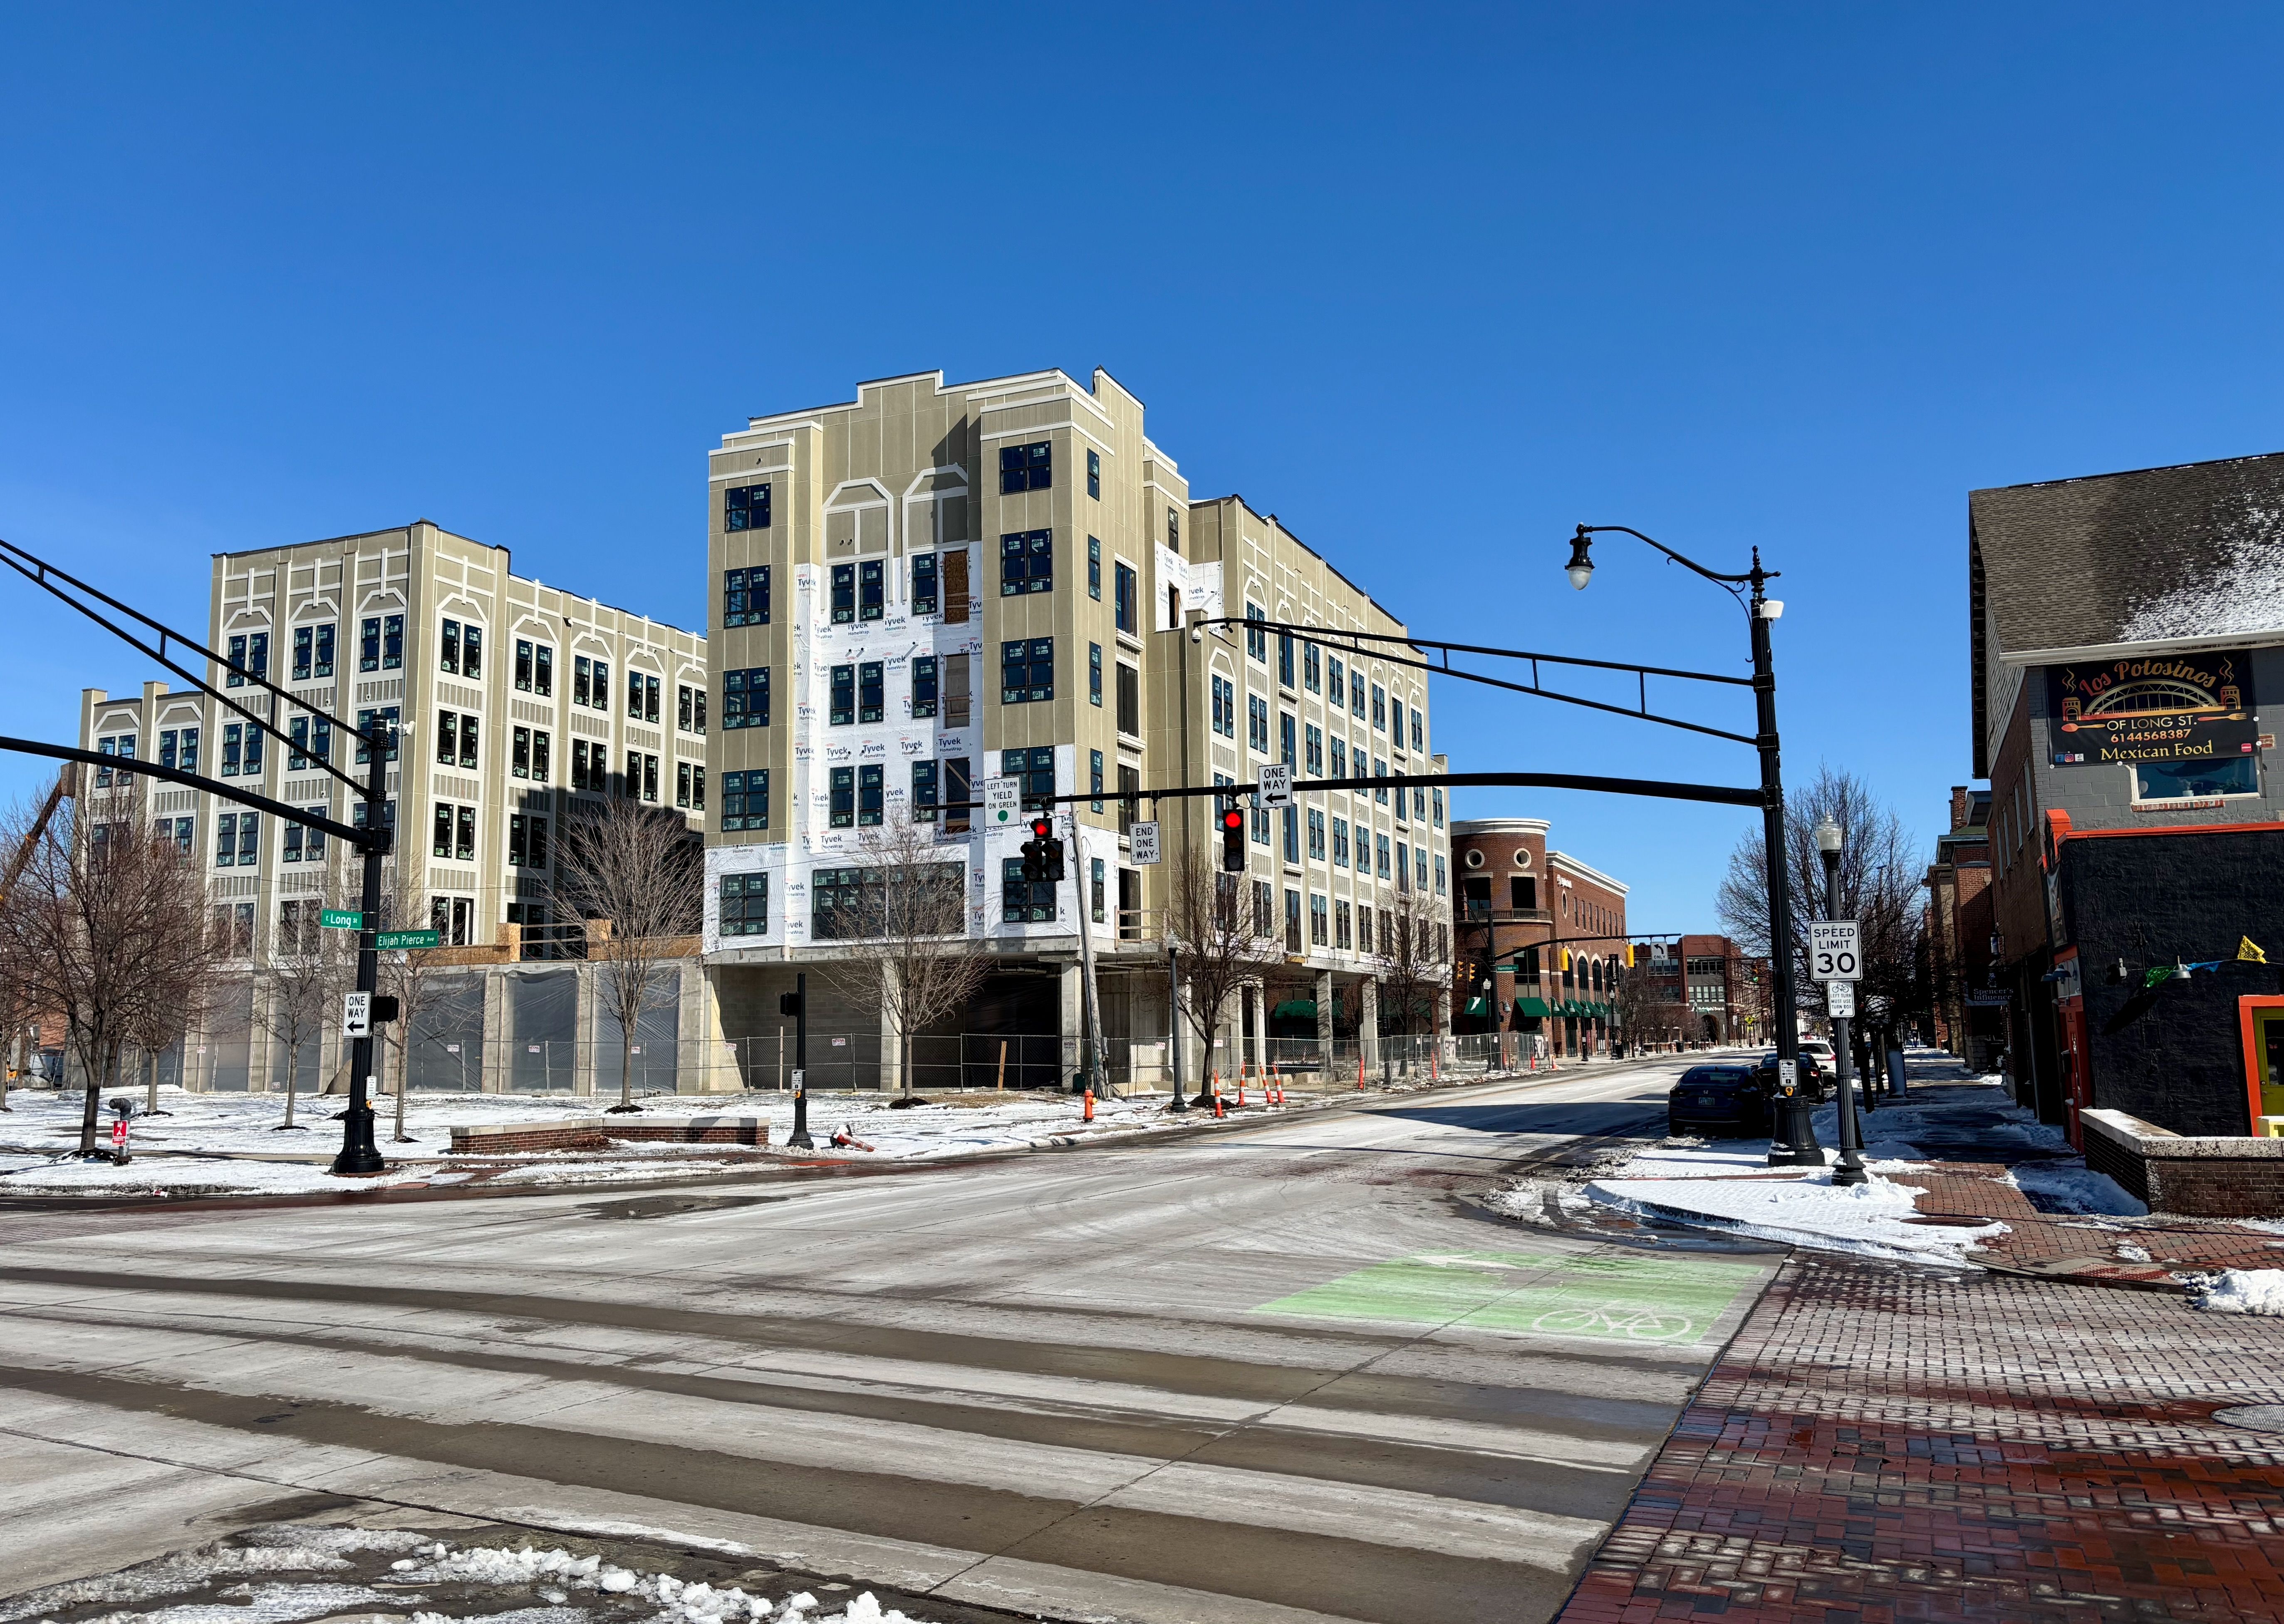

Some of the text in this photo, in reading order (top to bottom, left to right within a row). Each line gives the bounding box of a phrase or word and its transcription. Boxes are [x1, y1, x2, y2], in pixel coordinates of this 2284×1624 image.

[885, 616, 905, 626] Tyvek
[2080, 659, 2217, 696] Los Potosinos
[2107, 715, 2197, 731] OF LONG ST.
[2111, 729, 2192, 743] 6144568387
[901, 740, 922, 750] Tyvek
[939, 737, 961, 748] Tyvek
[826, 747, 847, 757] Tyvek
[863, 743, 885, 754] Tyvek
[2100, 739, 2213, 760] Mexican Food
[1264, 767, 1285, 778] ONE
[1263, 779, 1286, 790] WAY
[993, 791, 1012, 800] YIELD
[1136, 827, 1153, 836] END
[821, 834, 842, 844] Tyvek
[1137, 838, 1154, 847] ONE
[1136, 850, 1154, 859] WAY
[330, 914, 351, 928] Long
[1814, 928, 1855, 937] SPEED
[378, 936, 398, 948] Elijah
[401, 935, 424, 945] Pierce
[1819, 940, 1850, 949] LIMIT
[1817, 952, 1855, 974] 30
[349, 996, 365, 1006] ONE
[348, 1008, 365, 1018] WAY
